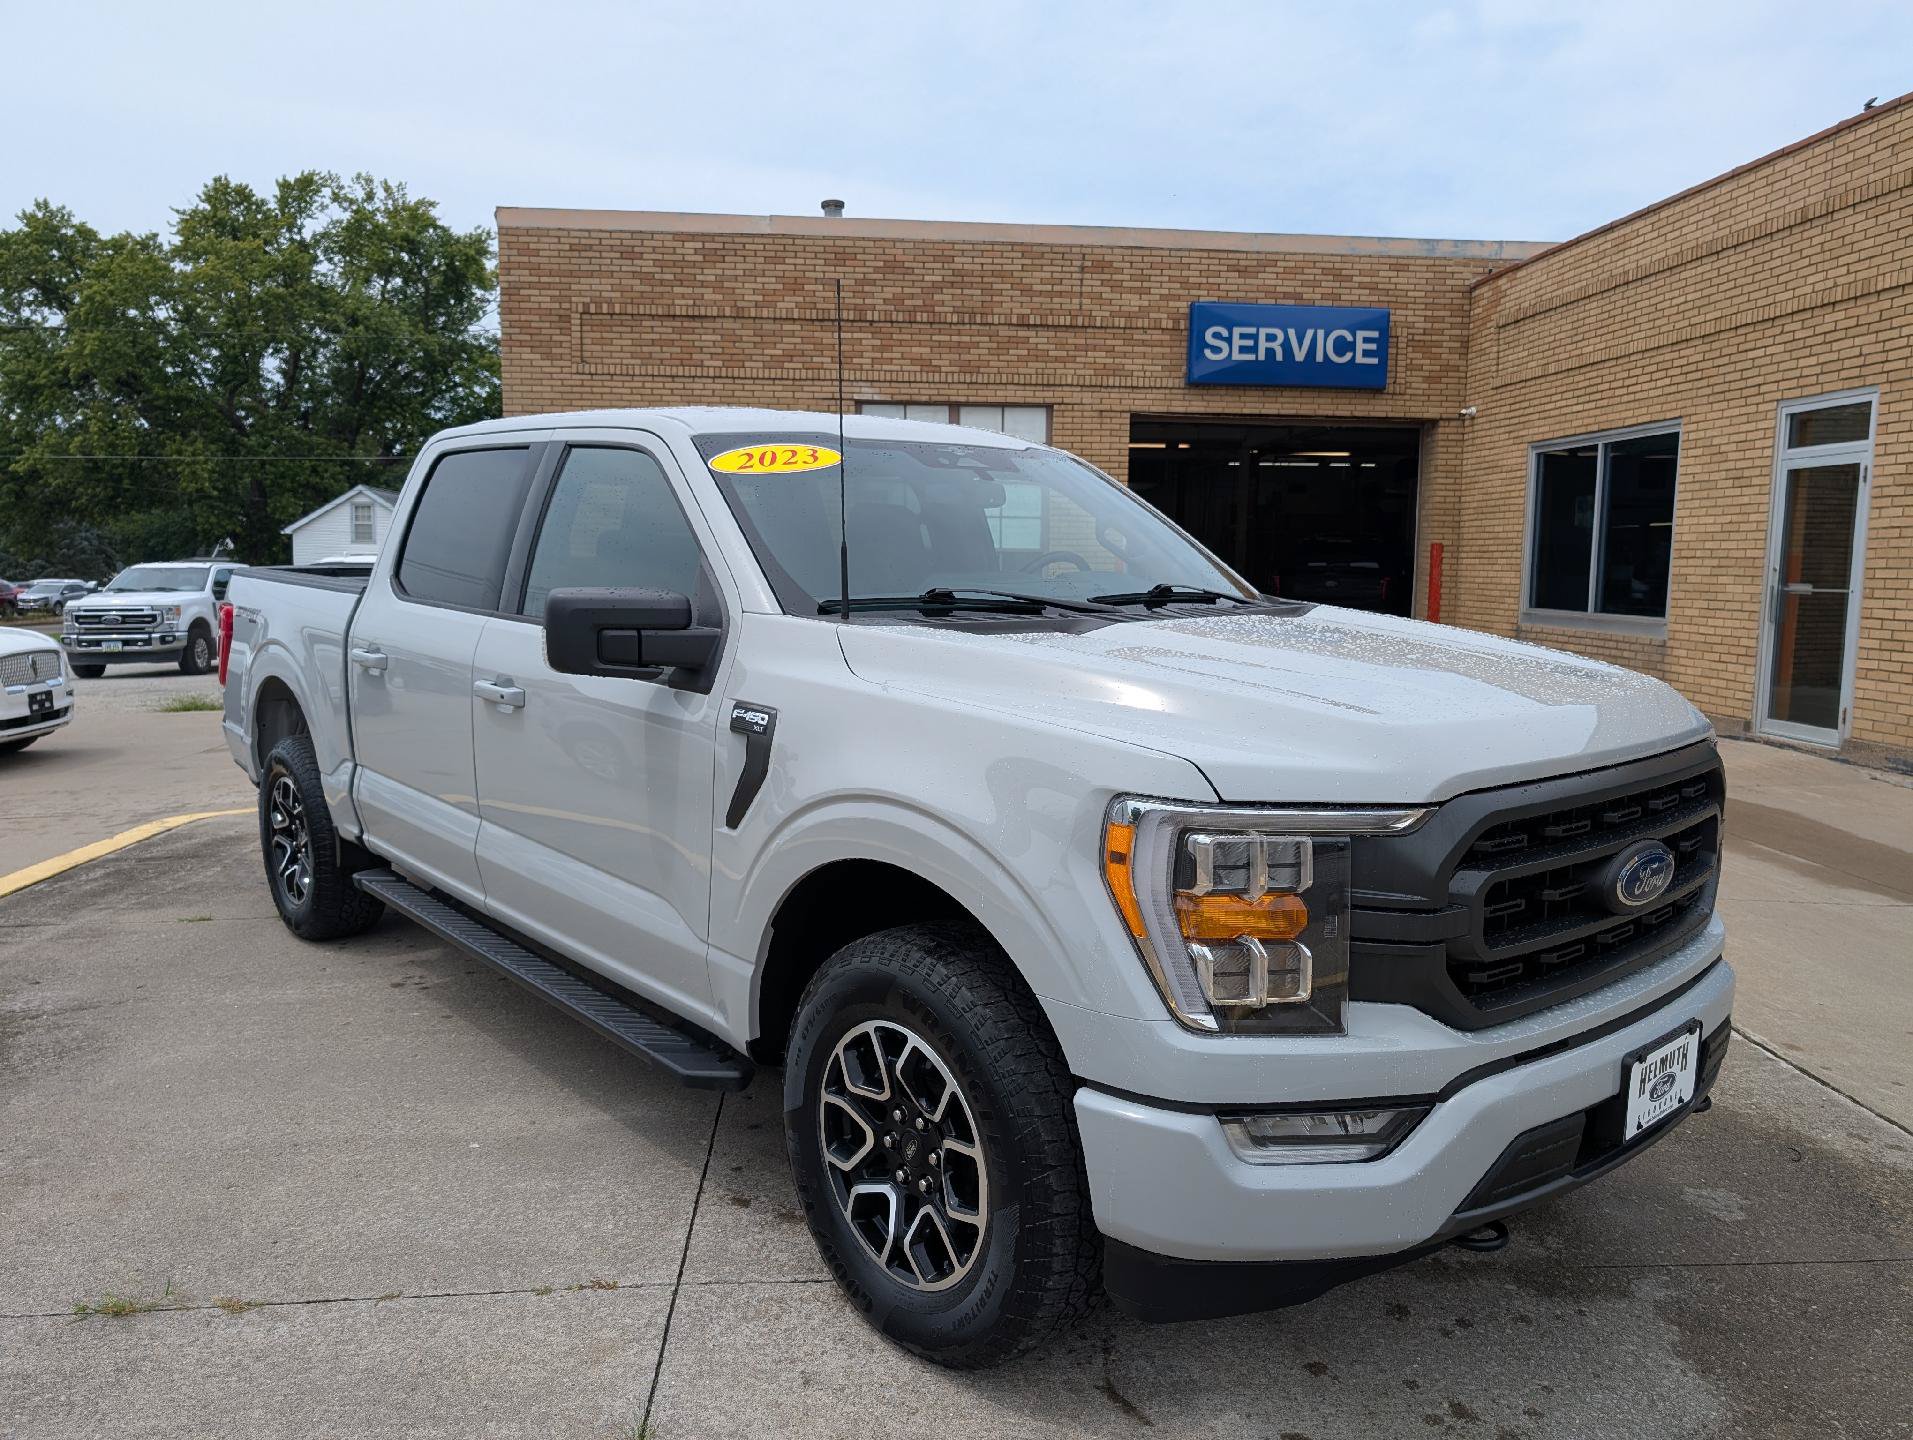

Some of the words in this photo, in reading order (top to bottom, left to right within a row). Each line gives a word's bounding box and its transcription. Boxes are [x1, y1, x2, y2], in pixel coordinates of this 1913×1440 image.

[1204, 326, 1379, 364] SERVICE
[737, 449, 819, 470] 2023
[1639, 1041, 1689, 1099] HELMUTH
